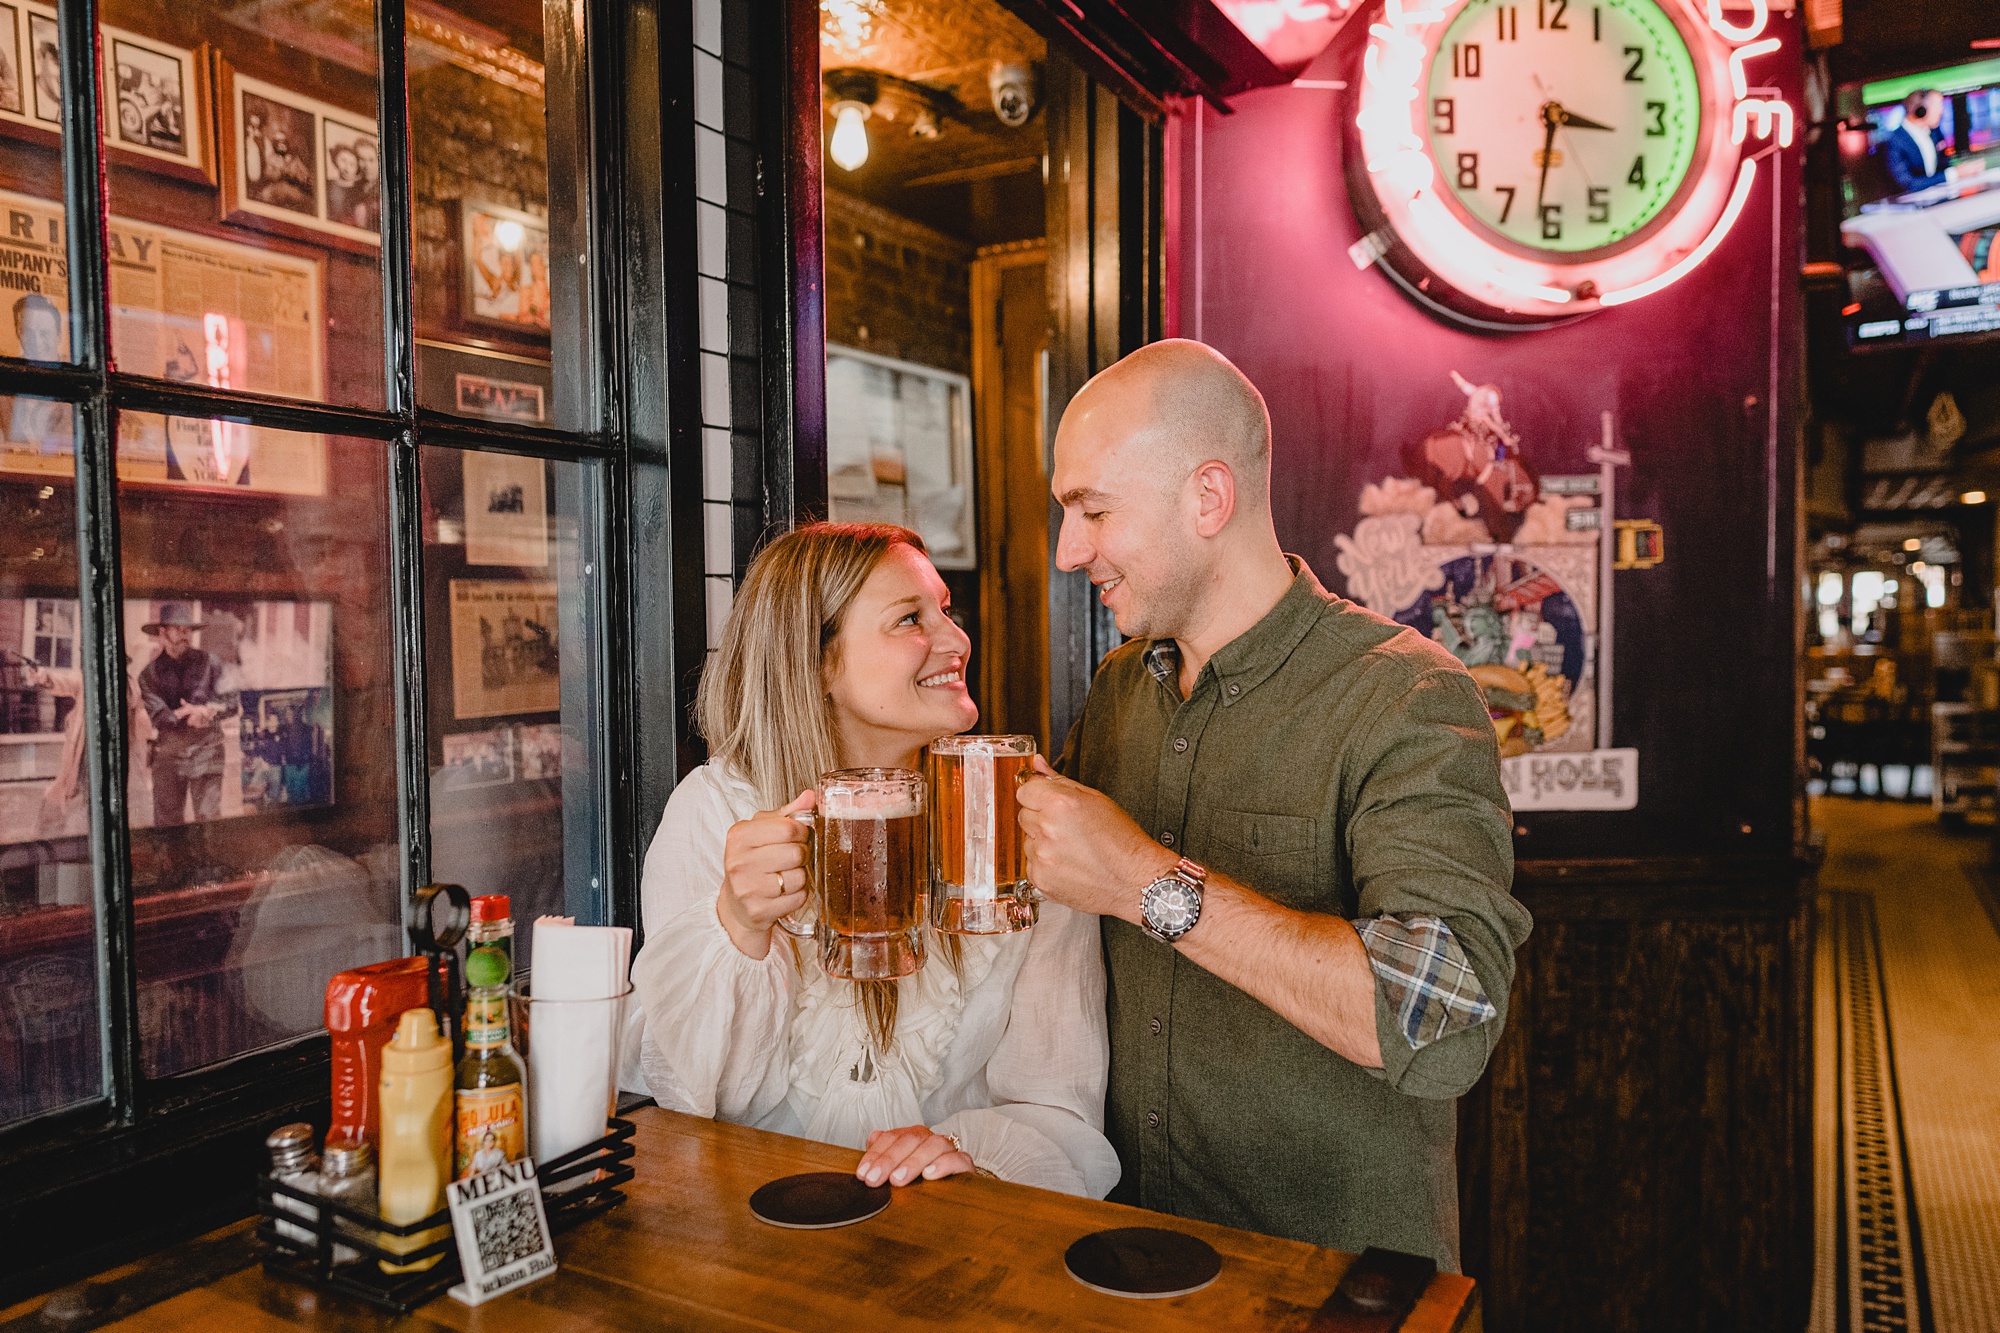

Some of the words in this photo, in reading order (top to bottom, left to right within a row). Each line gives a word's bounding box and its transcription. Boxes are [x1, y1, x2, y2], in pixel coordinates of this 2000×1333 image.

[1498, 7, 1517, 41] 11
[1538, 0, 1568, 30] 12
[1593, 7, 1602, 41] 1
[1454, 44, 1480, 78] 10
[1623, 47, 1644, 82] 2
[1433, 99, 1455, 134] 9
[1646, 101, 1666, 136] 3
[1457, 153, 1478, 189] 8
[1627, 155, 1646, 191] 4
[1495, 187, 1516, 223] 7
[1541, 205, 1561, 239] 6
[1588, 187, 1609, 223] 5
[457, 1158, 538, 1206] MENU
